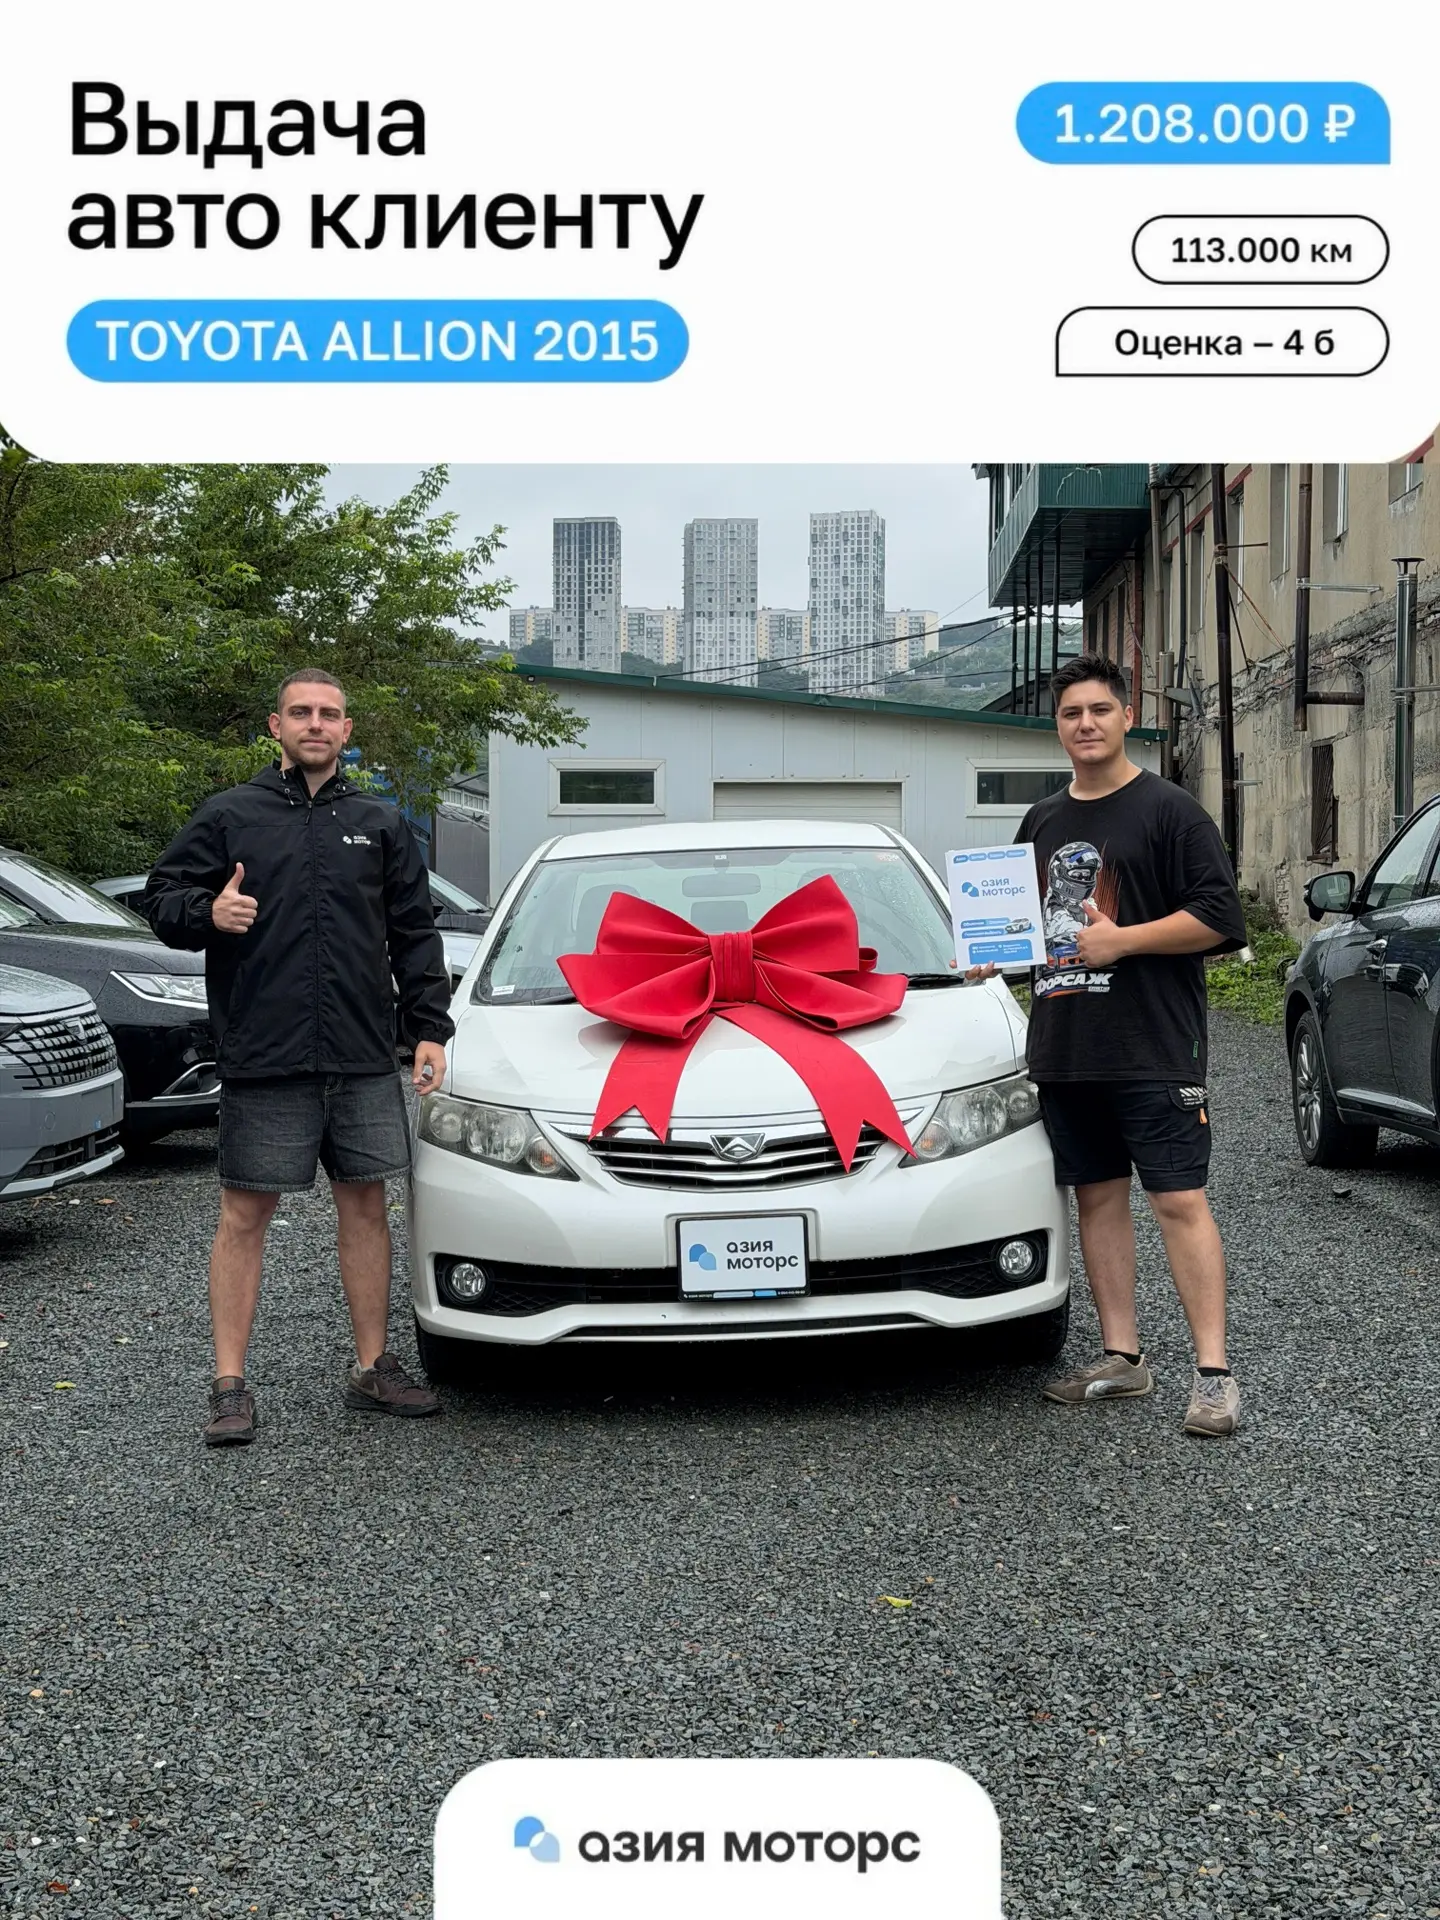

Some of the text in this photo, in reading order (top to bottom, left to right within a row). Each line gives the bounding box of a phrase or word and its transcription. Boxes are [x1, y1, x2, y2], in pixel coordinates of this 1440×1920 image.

[981, 878, 1010, 887] азия
[982, 886, 1026, 897] моторс
[1035, 973, 1114, 996] ФОРСАЖ
[726, 1240, 773, 1253] азия
[727, 1255, 799, 1272] моторс
